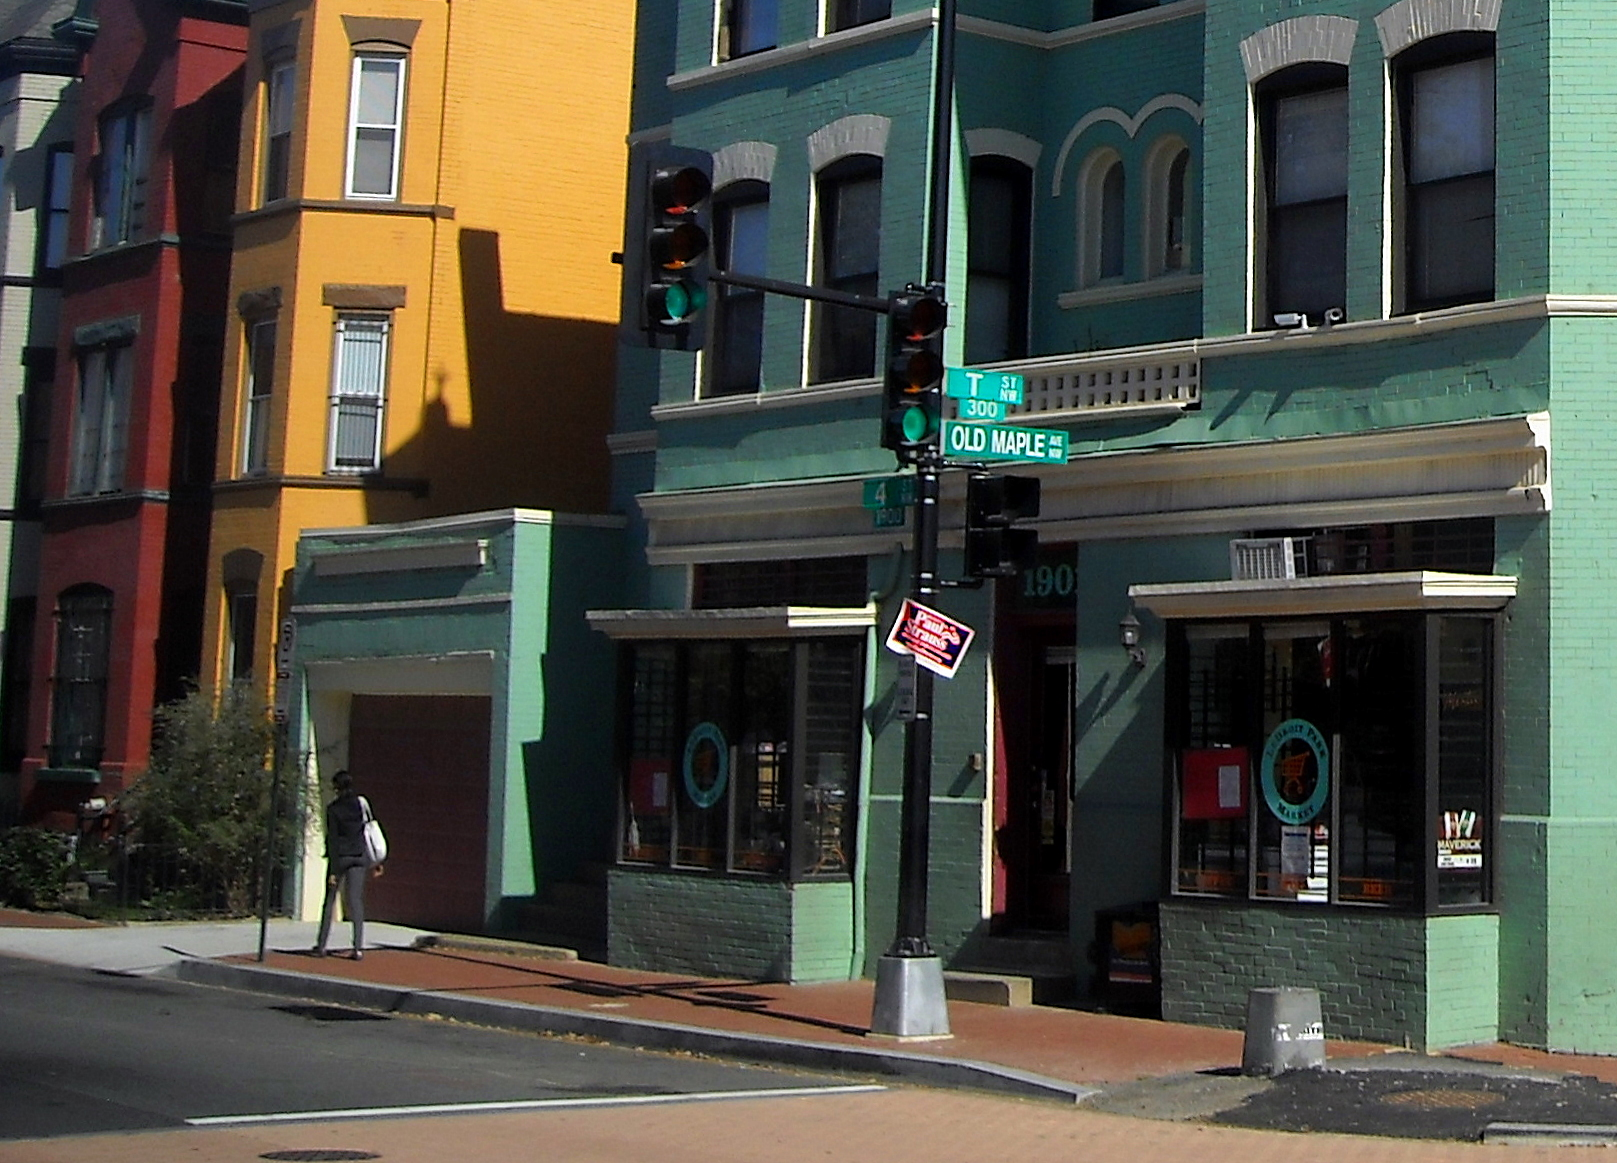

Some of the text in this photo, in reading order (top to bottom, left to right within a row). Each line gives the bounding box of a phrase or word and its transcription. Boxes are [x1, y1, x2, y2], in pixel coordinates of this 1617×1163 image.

[965, 371, 984, 397] T
[1001, 376, 1018, 389] ST
[1000, 388, 1018, 402] NW
[966, 399, 998, 418] 300
[950, 425, 1046, 458] OLD MAPLE
[1048, 435, 1063, 447] AVE
[914, 609, 944, 635] Paul
